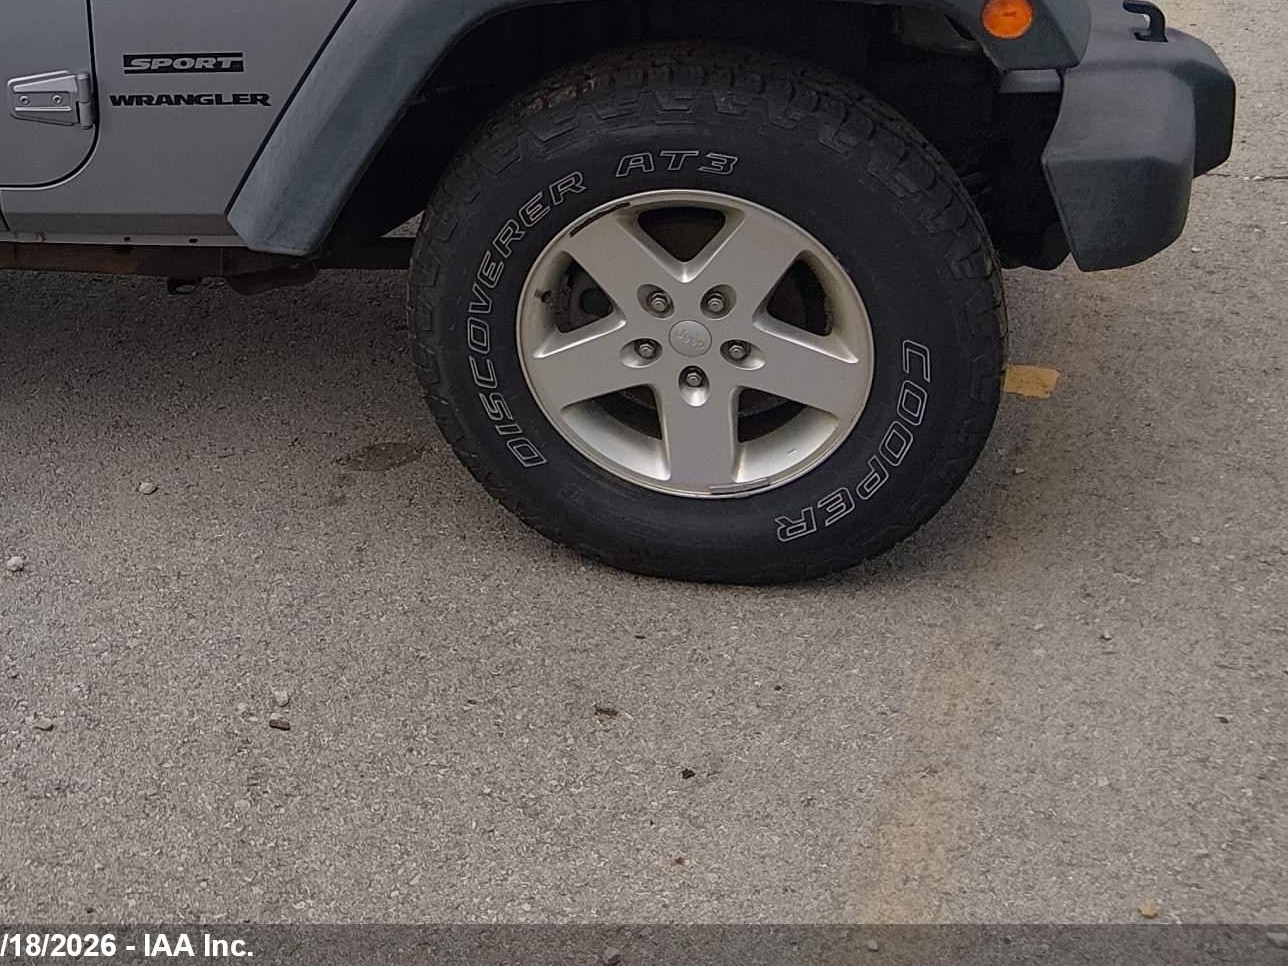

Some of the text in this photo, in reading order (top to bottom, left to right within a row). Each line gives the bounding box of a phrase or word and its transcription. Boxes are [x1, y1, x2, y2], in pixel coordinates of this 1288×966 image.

[109, 94, 272, 107] WRANGLER
[123, 55, 244, 72] SPORT
[466, 149, 739, 469] DISCOVERER AT3
[773, 338, 932, 543] COOPER
